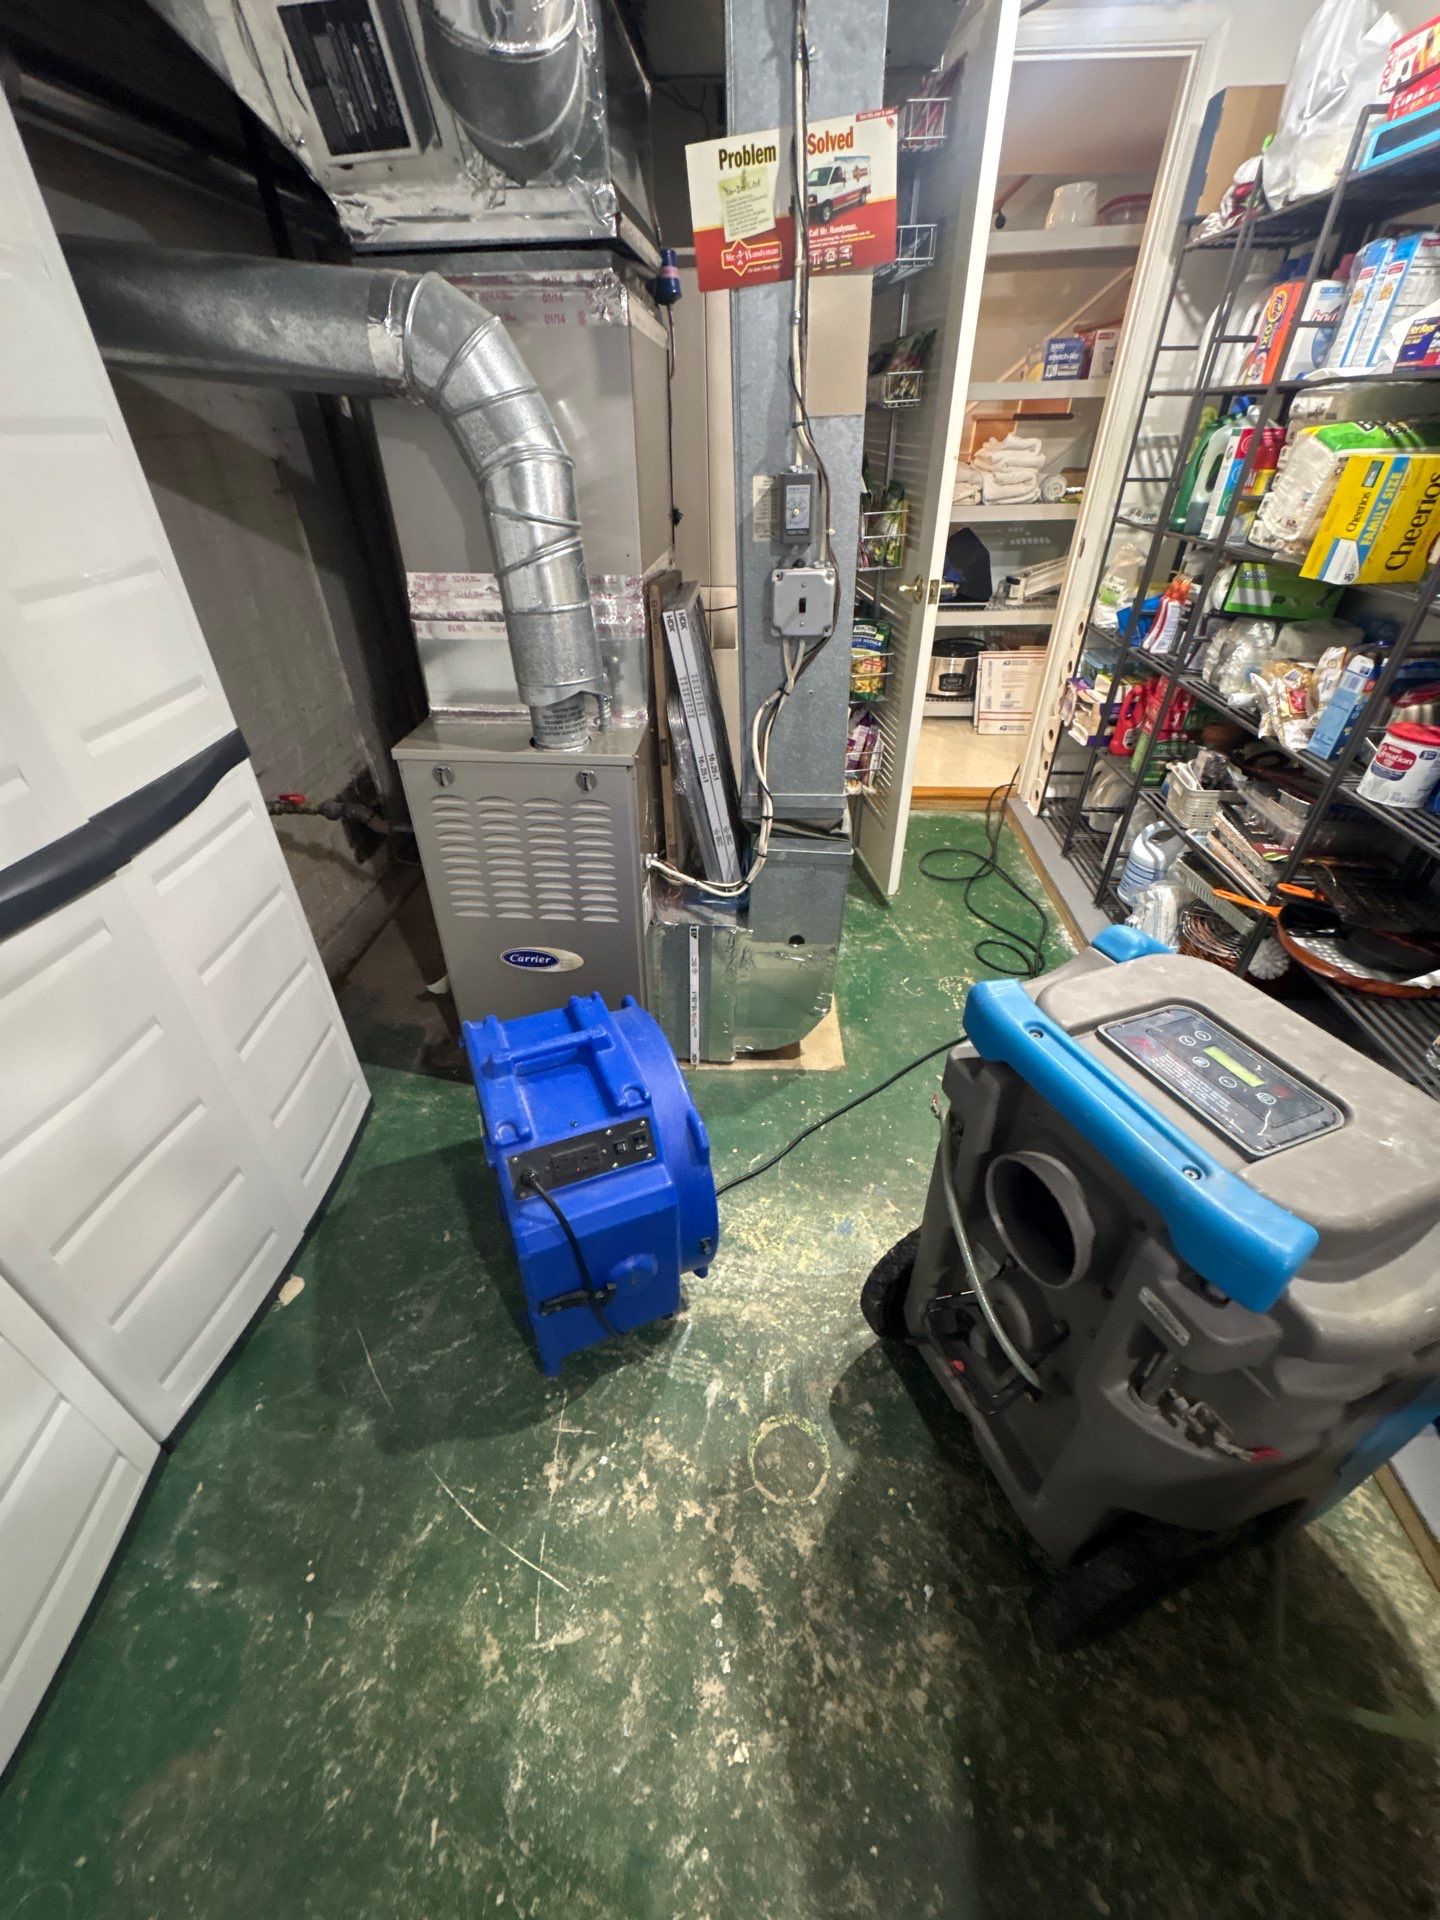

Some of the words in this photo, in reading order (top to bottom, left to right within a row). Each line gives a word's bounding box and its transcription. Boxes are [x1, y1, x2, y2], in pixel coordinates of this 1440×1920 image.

[807, 125, 854, 155] Solved
[718, 144, 777, 170] Problem
[745, 247, 779, 261] Handyman
[544, 313, 566, 325] 01/14
[1346, 491, 1372, 532] Cheerios
[1384, 471, 1440, 571] Cheerios
[666, 614, 676, 633] HDX
[678, 612, 688, 630] HDX
[509, 953, 552, 964] Carrier
